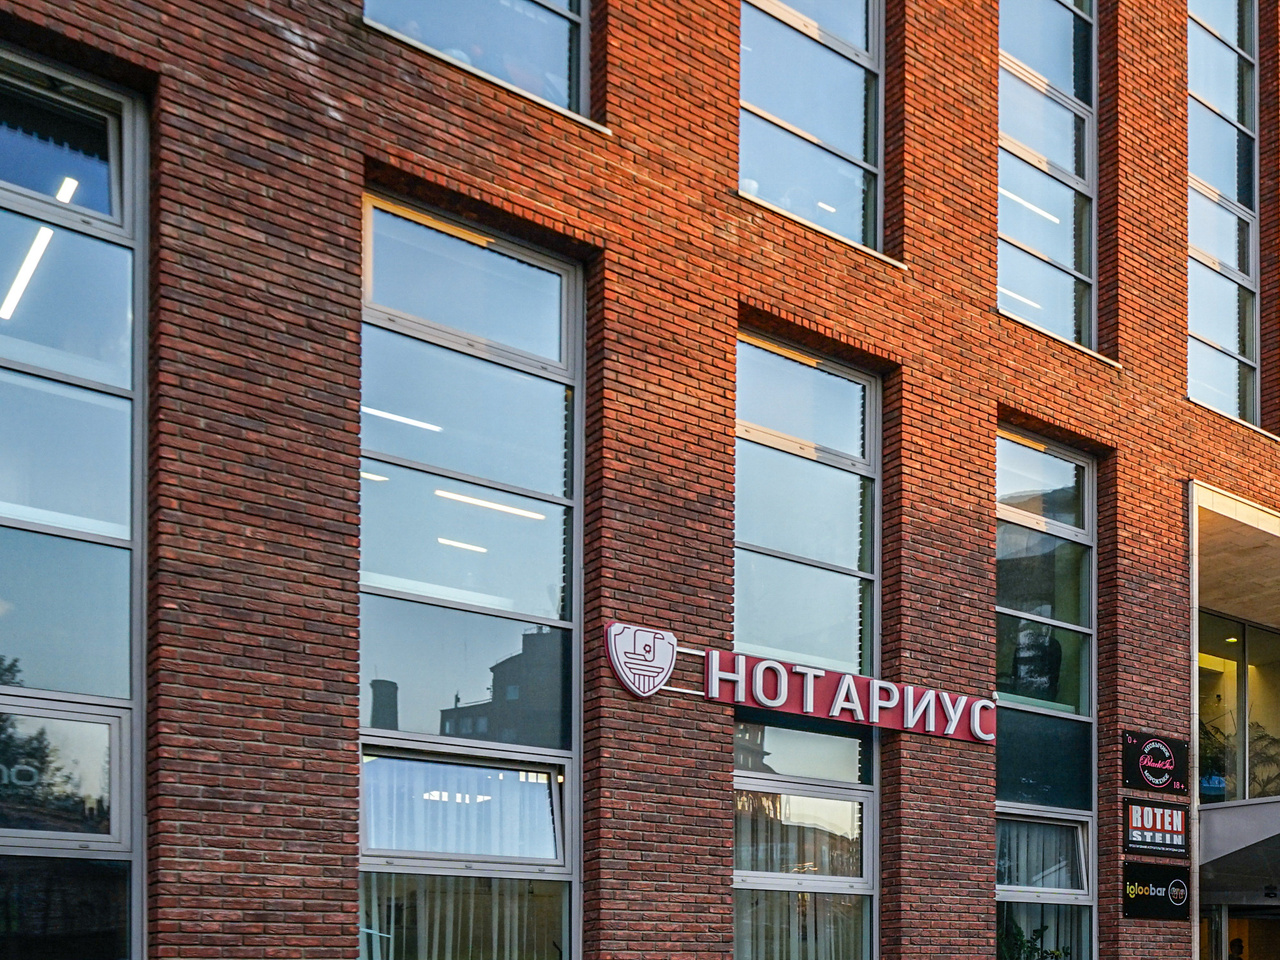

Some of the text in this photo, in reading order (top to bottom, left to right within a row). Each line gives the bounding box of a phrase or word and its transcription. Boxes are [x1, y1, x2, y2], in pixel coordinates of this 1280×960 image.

[706, 649, 996, 742] НОТАРИУС
[1131, 805, 1183, 832] ROTEN
[1132, 830, 1182, 845] STEIN
[1126, 882, 1166, 898] igloobar
